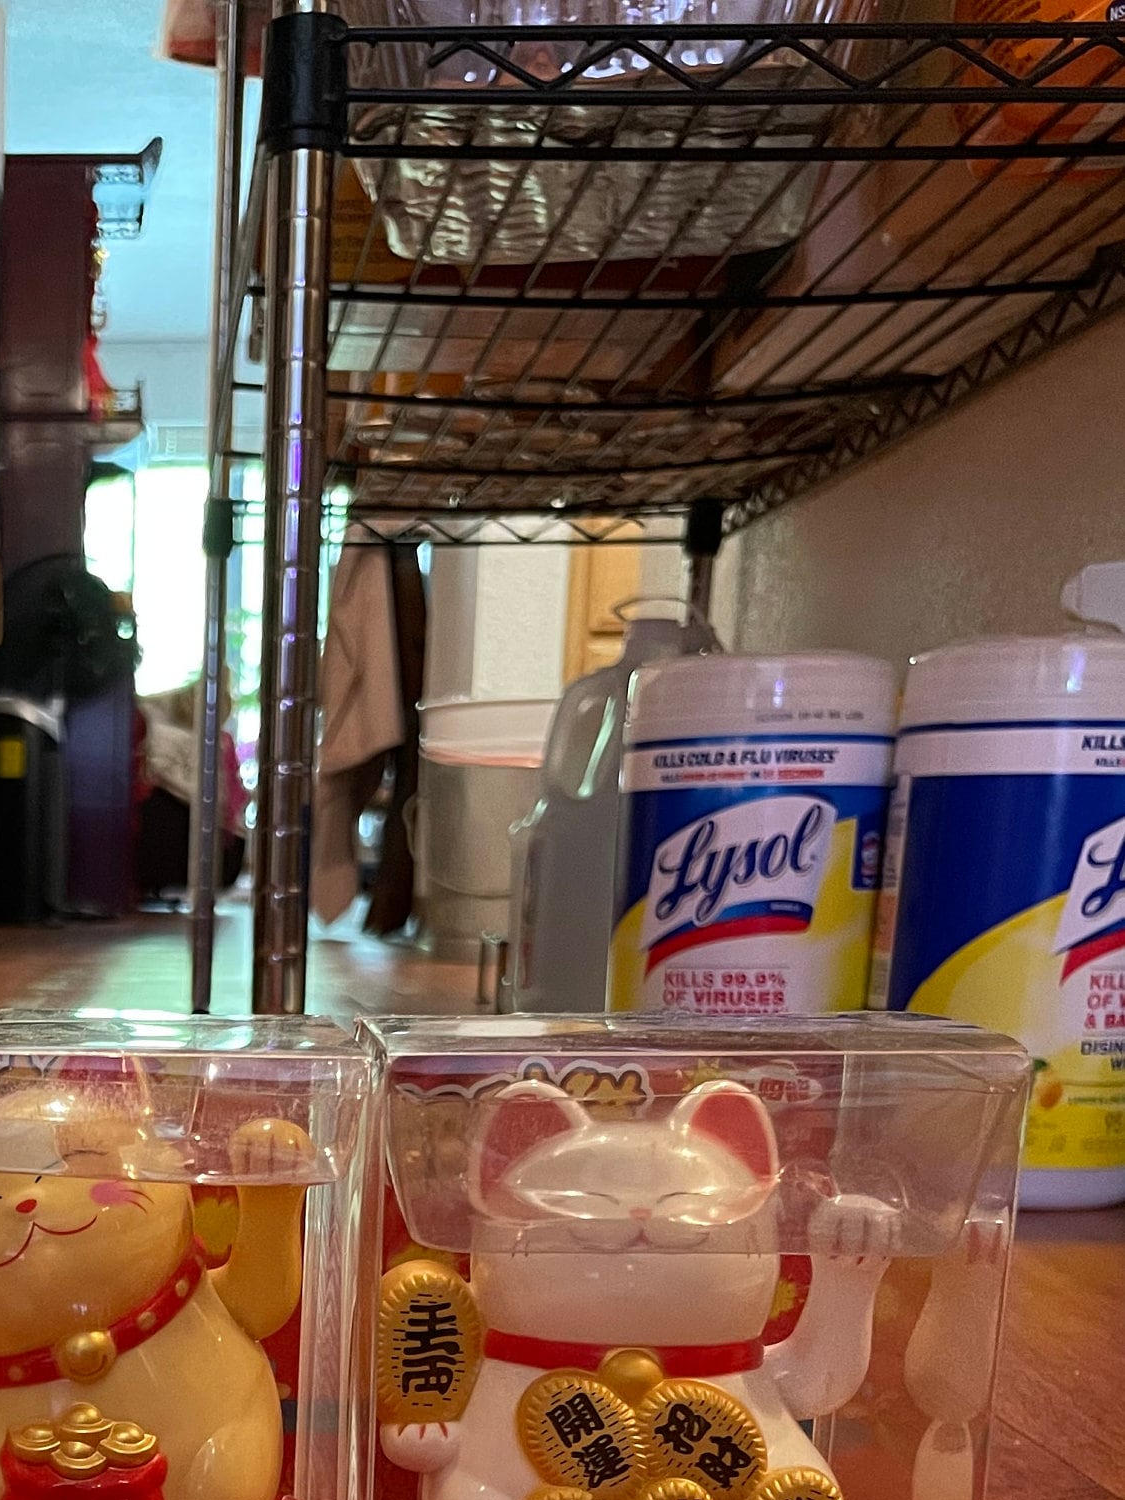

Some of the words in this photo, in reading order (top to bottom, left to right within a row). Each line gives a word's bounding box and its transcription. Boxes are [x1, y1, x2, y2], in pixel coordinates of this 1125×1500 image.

[652, 754, 686, 769] KILLS
[687, 752, 724, 767] COLD
[727, 751, 737, 765] &
[740, 750, 772, 764] FLU
[775, 748, 837, 763] VIRUSES
[655, 803, 822, 922] Lysol
[664, 971, 714, 988] KILLS
[663, 990, 686, 1006] OF
[693, 990, 785, 1006] VIRUSES
[1087, 993, 1112, 1010] OF
[545, 1392, 631, 1489] 開運
